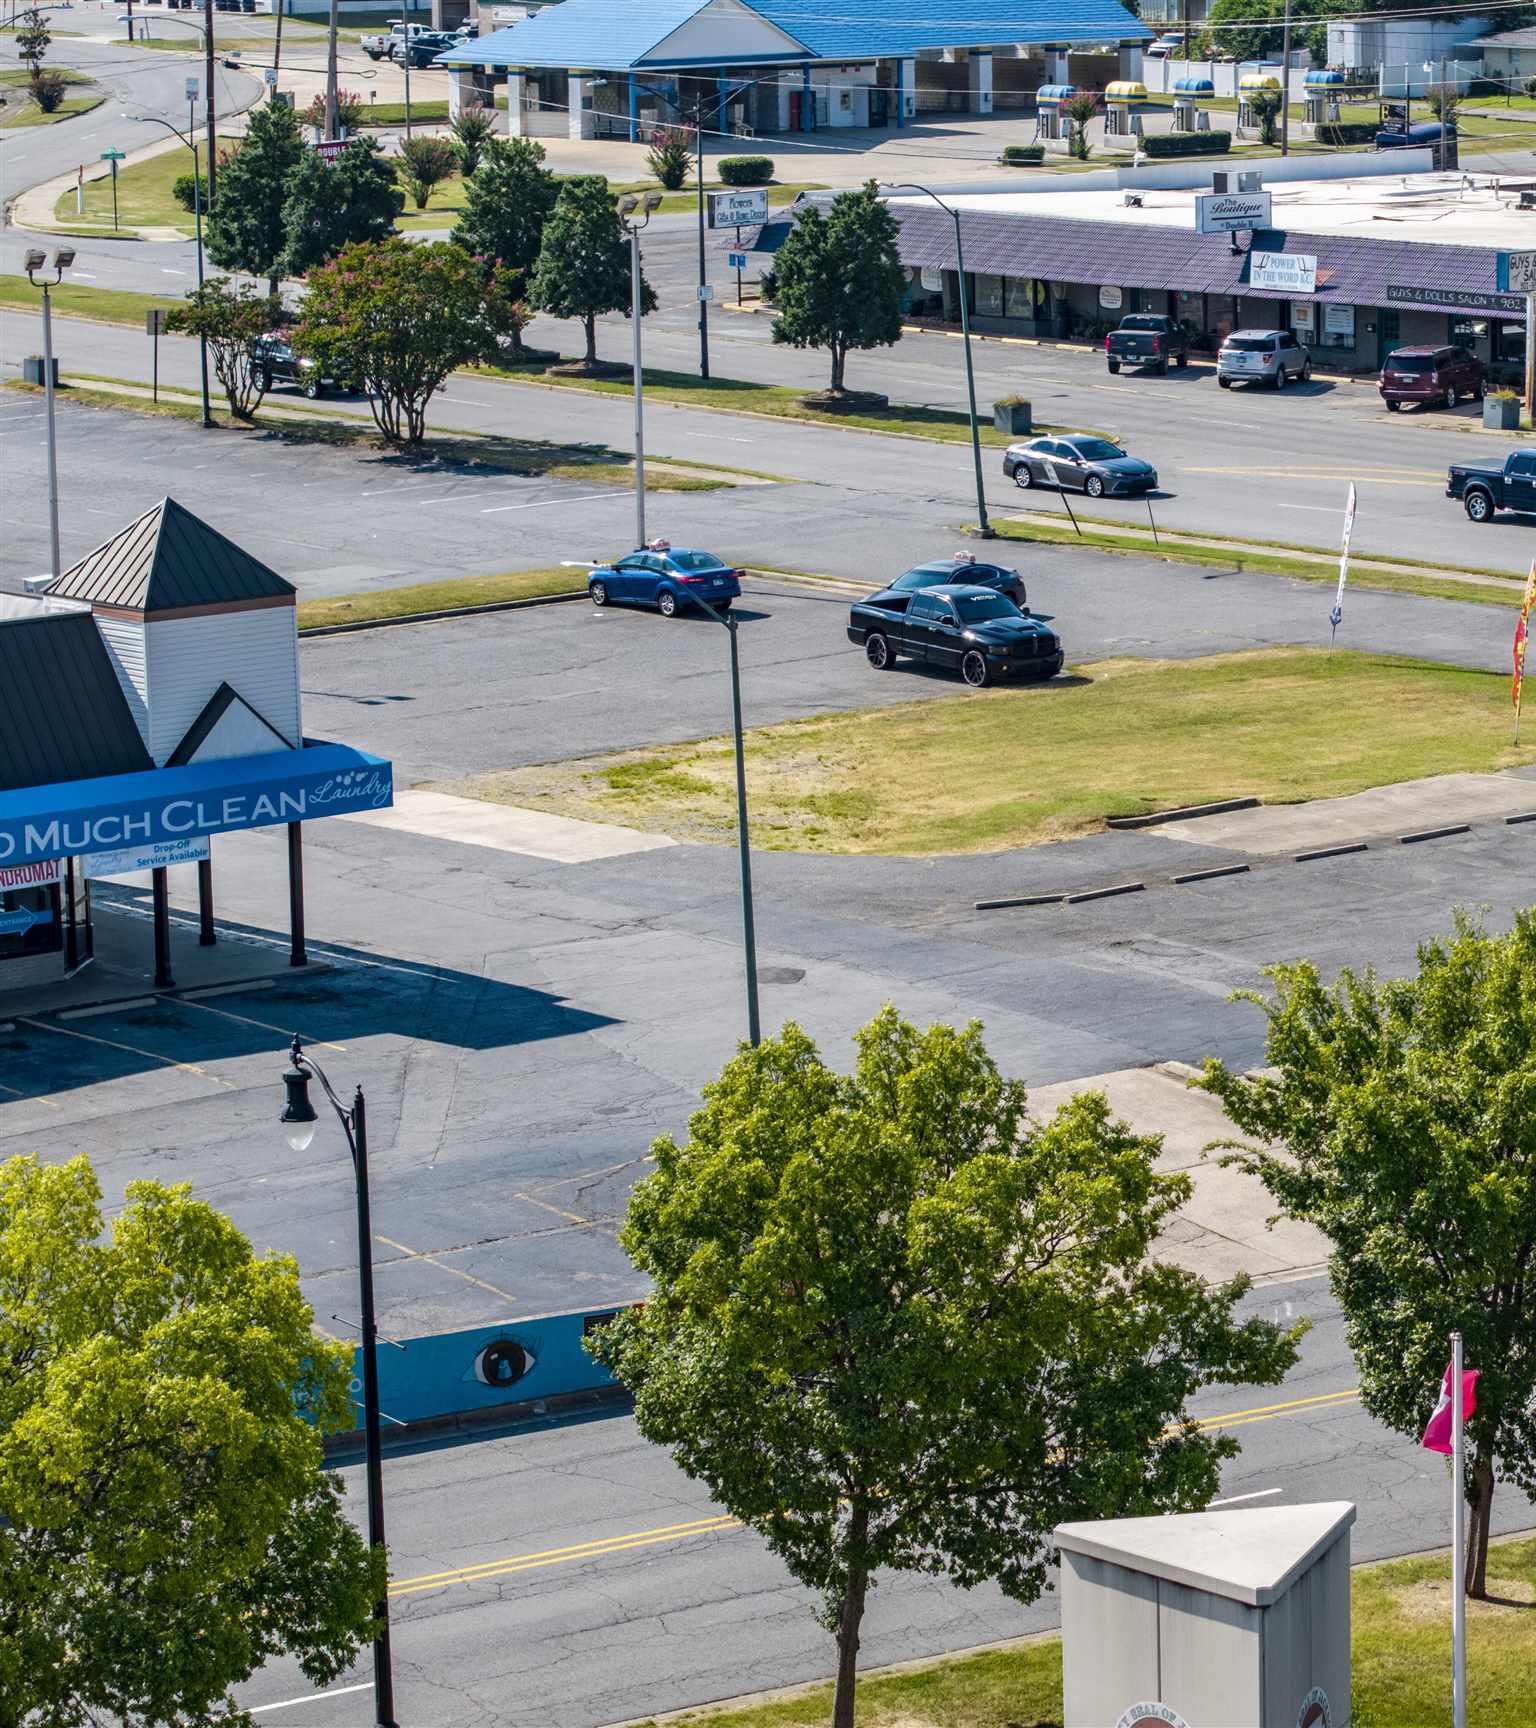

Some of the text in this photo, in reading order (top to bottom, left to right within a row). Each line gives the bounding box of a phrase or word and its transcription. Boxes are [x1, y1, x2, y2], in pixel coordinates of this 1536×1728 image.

[1210, 202, 1263, 214] Boutique
[1271, 259, 1295, 269] POWER
[1510, 255, 1530, 269] GUYS
[1263, 271, 1275, 281] THE
[1389, 288, 1412, 299] GUYS
[1424, 290, 1455, 304] DOLLS
[1457, 293, 1488, 306] SALON
[308, 771, 392, 807] Laundry
[25, 811, 150, 855] MUCH
[161, 789, 307, 832] CLEAN
[153, 839, 191, 854] Drop-Off
[136, 853, 167, 867] Service
[1130, 1703, 1159, 1720] SEAL
